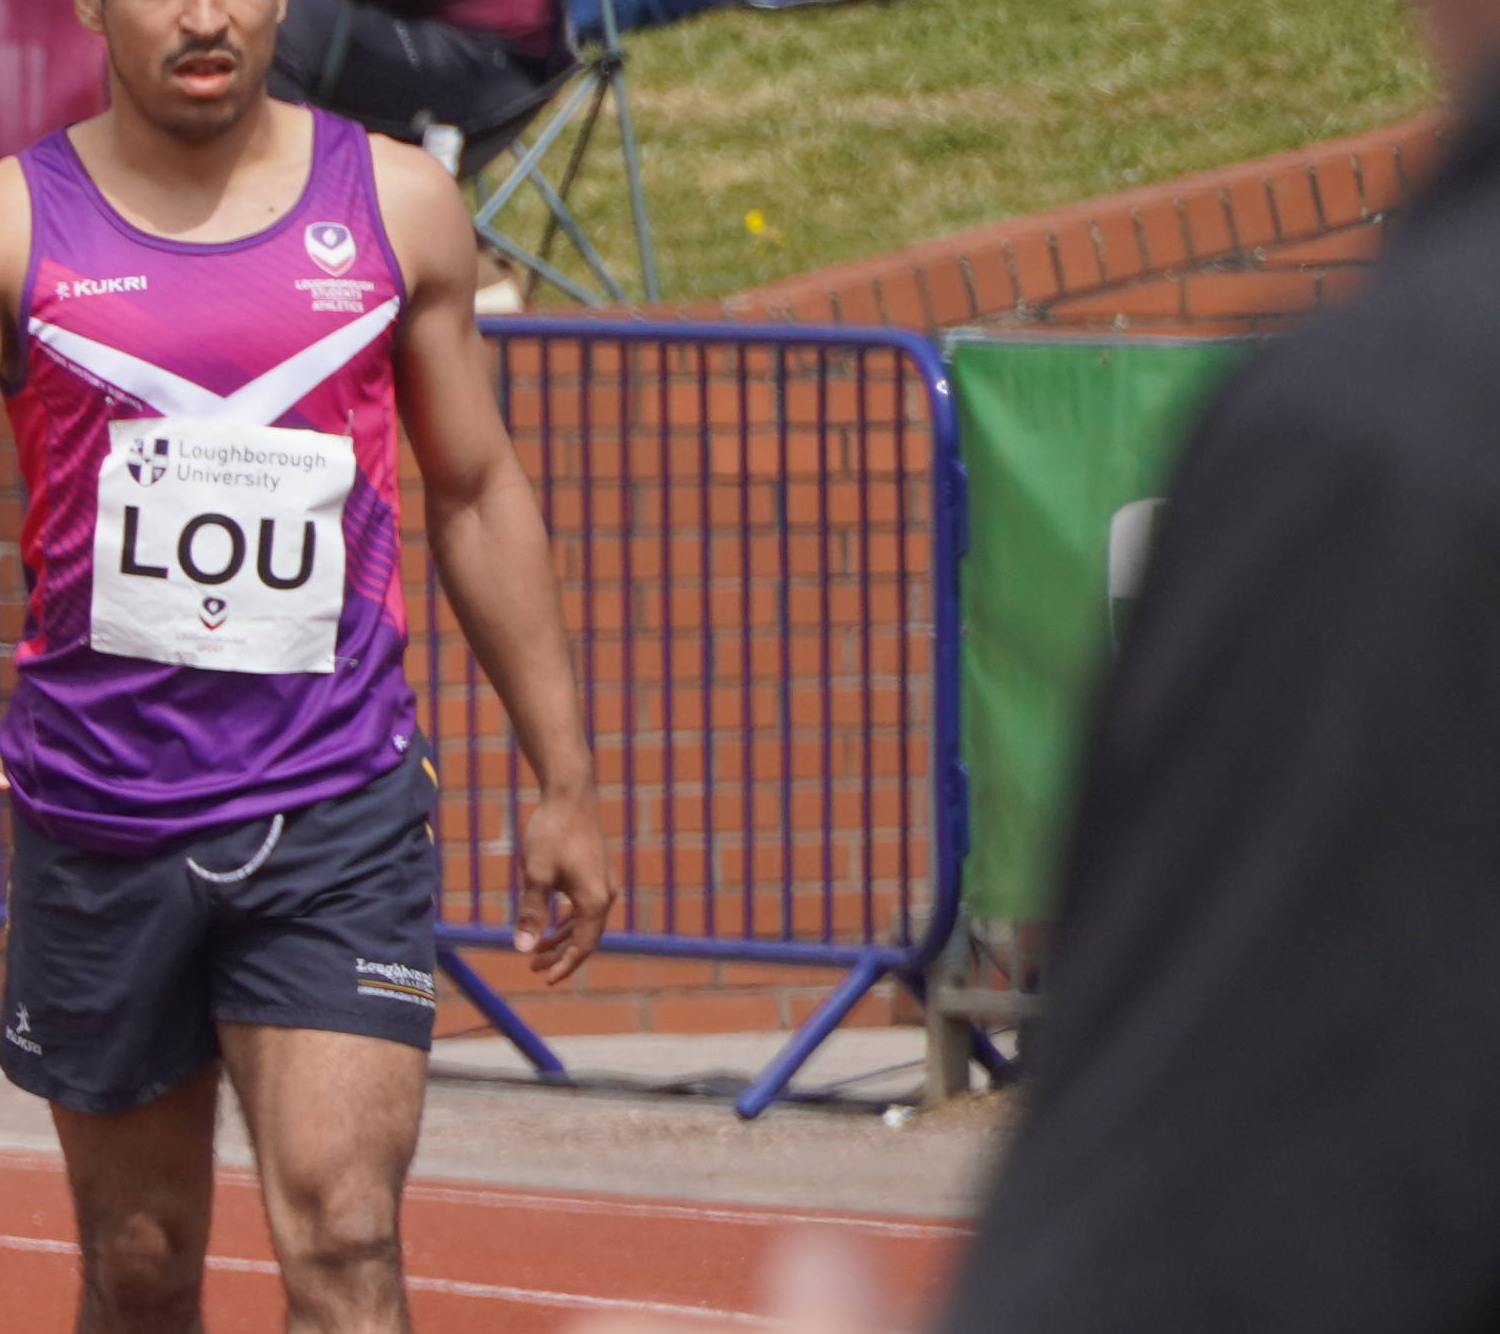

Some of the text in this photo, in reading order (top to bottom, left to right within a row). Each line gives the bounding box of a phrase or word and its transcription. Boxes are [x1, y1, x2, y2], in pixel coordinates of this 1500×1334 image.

[73, 275, 148, 297] KUKRI
[178, 441, 326, 473] Loughborough
[177, 464, 281, 492] University
[120, 505, 317, 591] LOU
